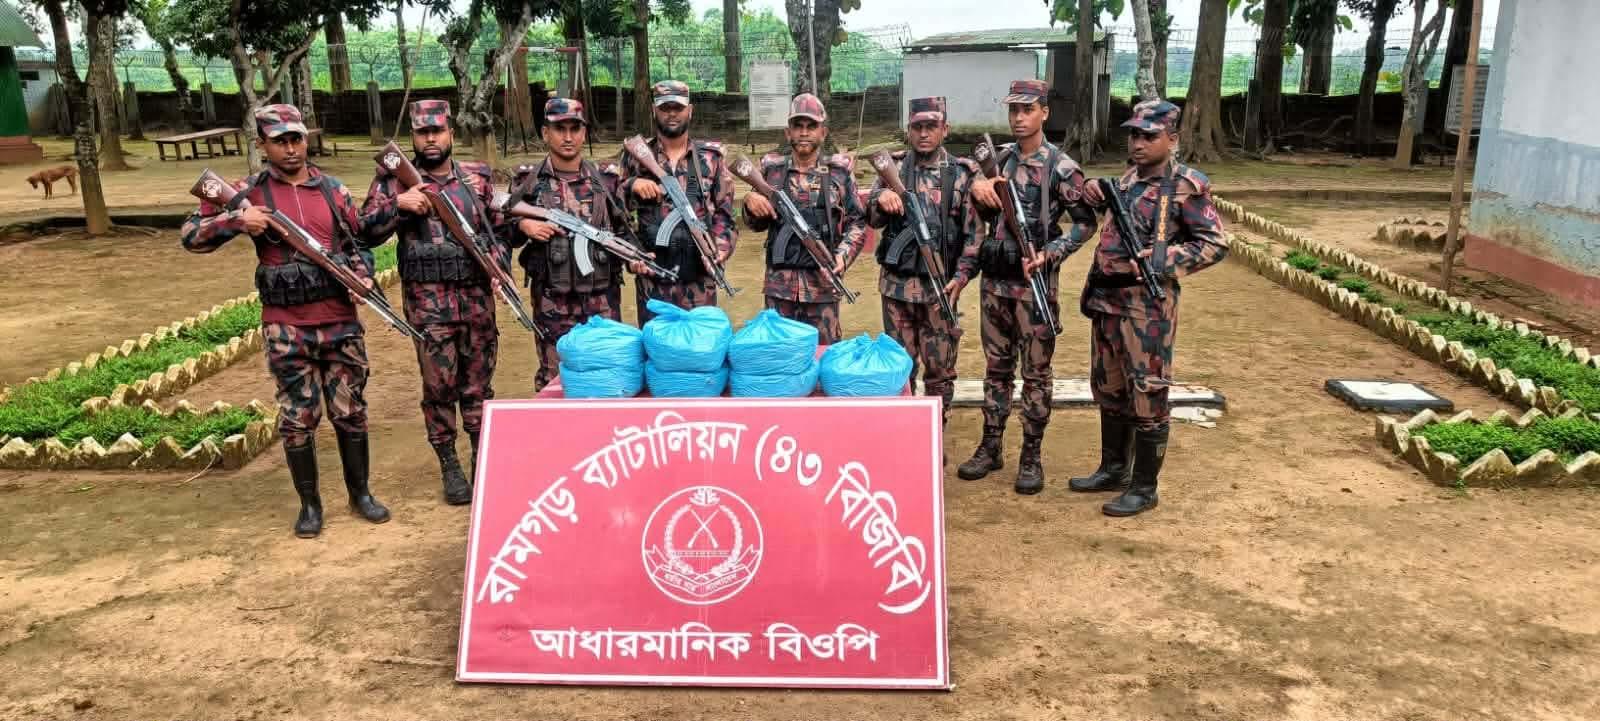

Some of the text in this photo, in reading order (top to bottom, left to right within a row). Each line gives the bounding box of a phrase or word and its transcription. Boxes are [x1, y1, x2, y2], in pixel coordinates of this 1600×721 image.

[476, 409, 932, 614] রামগড় ব্যাটালিয়ন (৪৩ বিজিবি)
[530, 621, 879, 662] আধারমানিক বিওপি
